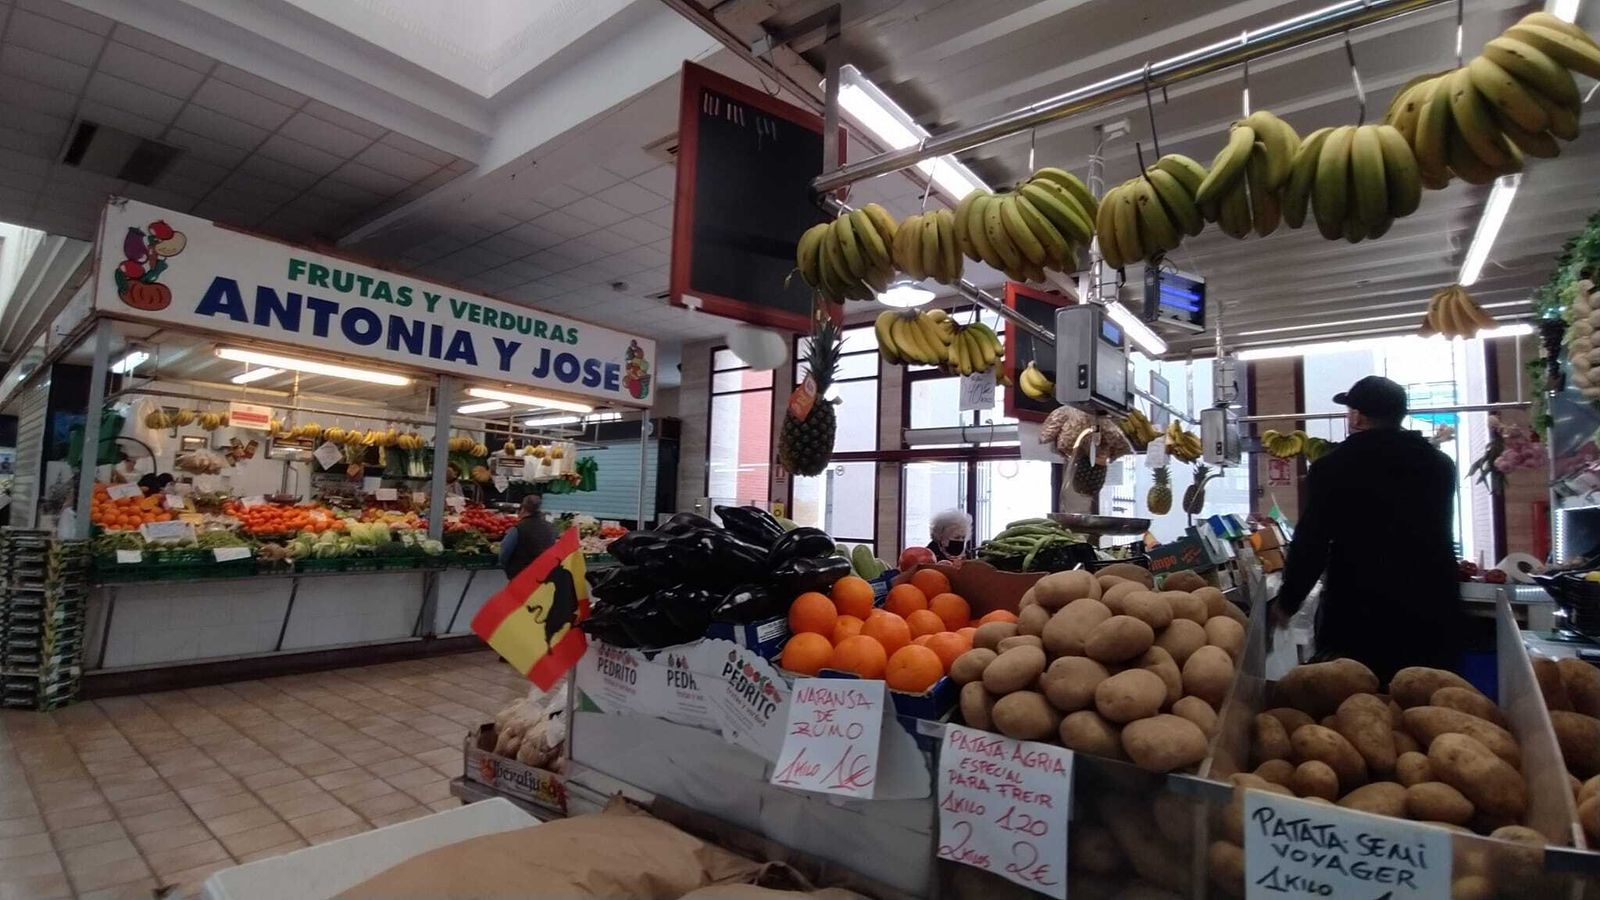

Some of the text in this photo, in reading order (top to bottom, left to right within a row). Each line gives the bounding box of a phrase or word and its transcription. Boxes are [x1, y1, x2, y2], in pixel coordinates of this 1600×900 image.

[287, 258, 579, 345] FRUTAS Y VERDURAS
[194, 276, 478, 366] ANTONIA
[492, 336, 522, 372] Y
[597, 657, 637, 685] PEDRITO
[790, 722, 864, 740] ZUMO
[813, 708, 837, 722] DE
[950, 730, 1066, 777] PATATA AGRIA
[960, 757, 1023, 784] ESPECIAL
[949, 769, 1053, 809] PARA FREIR
[1271, 843, 1418, 890] VOYAGER
